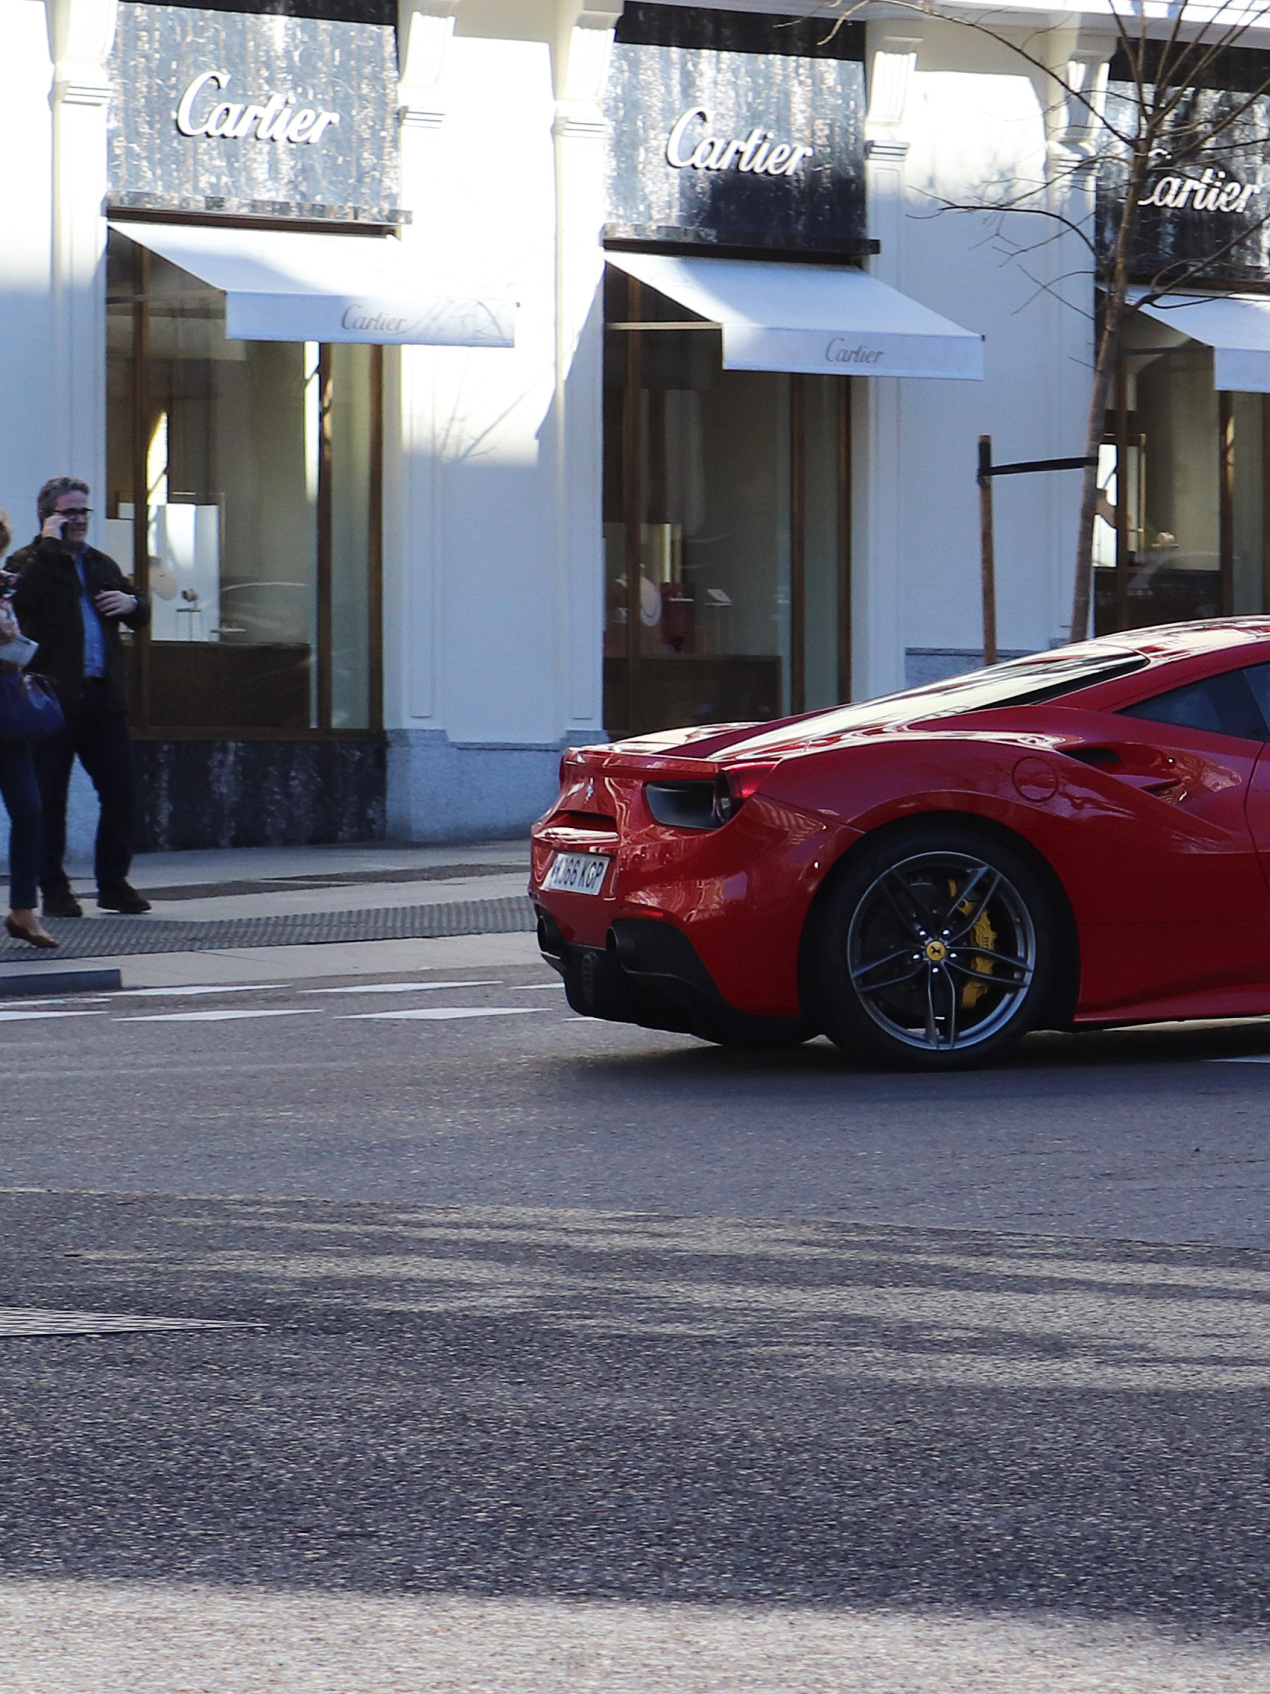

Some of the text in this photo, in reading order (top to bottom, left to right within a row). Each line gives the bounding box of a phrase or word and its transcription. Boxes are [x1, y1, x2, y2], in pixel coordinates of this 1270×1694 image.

[177, 71, 342, 144] Cartier
[667, 106, 815, 177] Cartier
[341, 304, 408, 331] Cartier
[825, 336, 885, 363] Cartier
